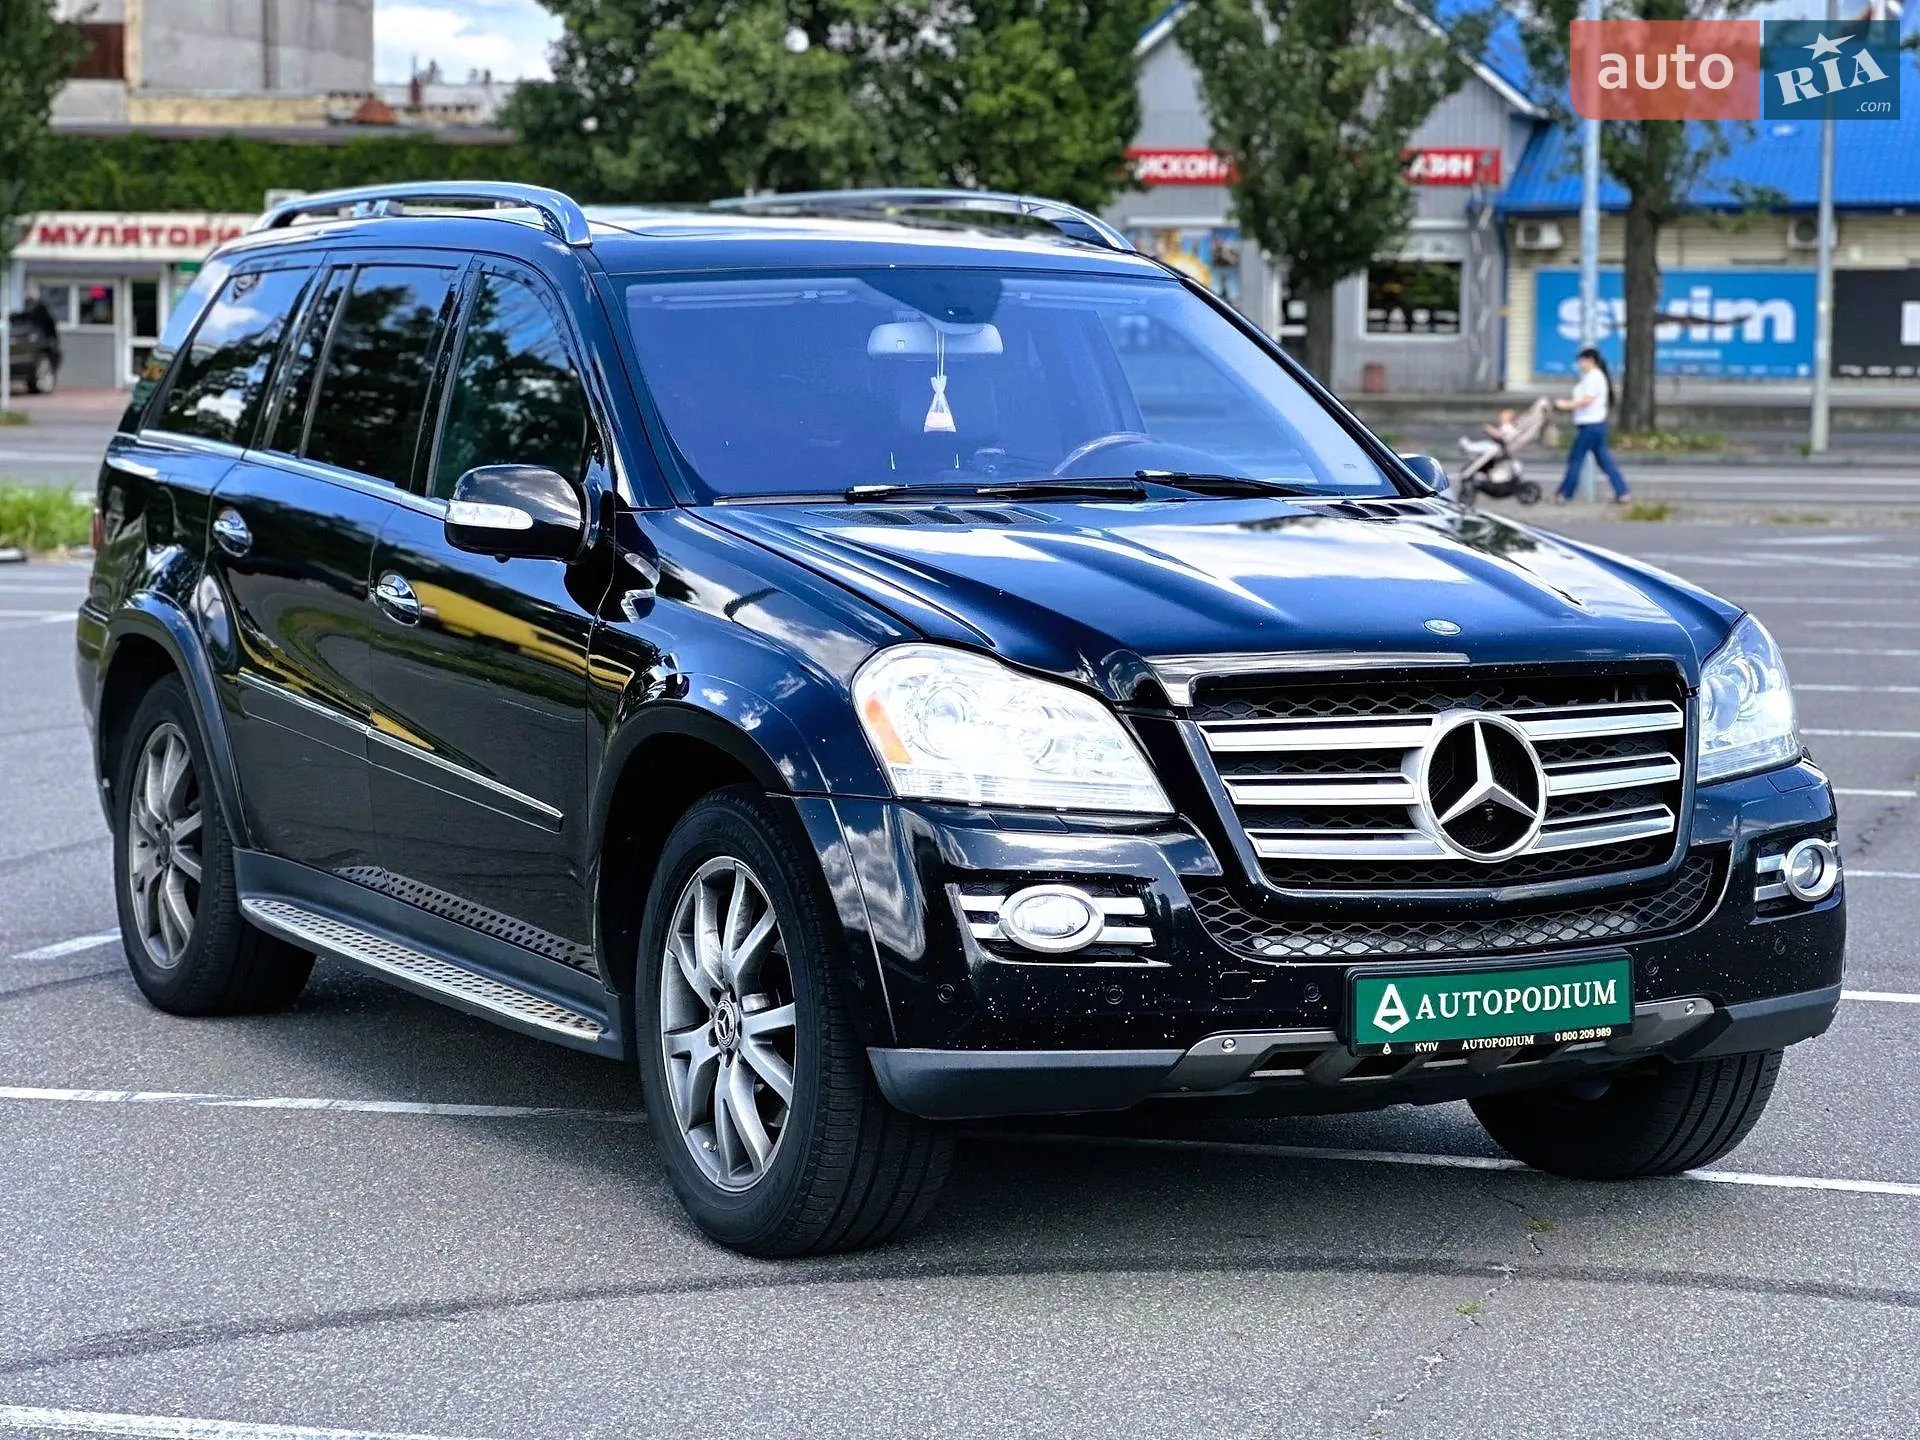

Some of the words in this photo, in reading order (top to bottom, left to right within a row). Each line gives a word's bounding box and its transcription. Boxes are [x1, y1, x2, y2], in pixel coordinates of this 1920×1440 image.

[1556, 285, 1796, 343] swim
[1415, 979, 1617, 1020] AUTOPODIUM
[1415, 1042, 1439, 1052] KYIV
[1461, 1034, 1535, 1050] AUTOPODIUM
[1554, 1032, 1561, 1042] 0
[1562, 1030, 1578, 1041] 800
[1579, 1028, 1595, 1039] 209
[1596, 1026, 1612, 1037] 989
